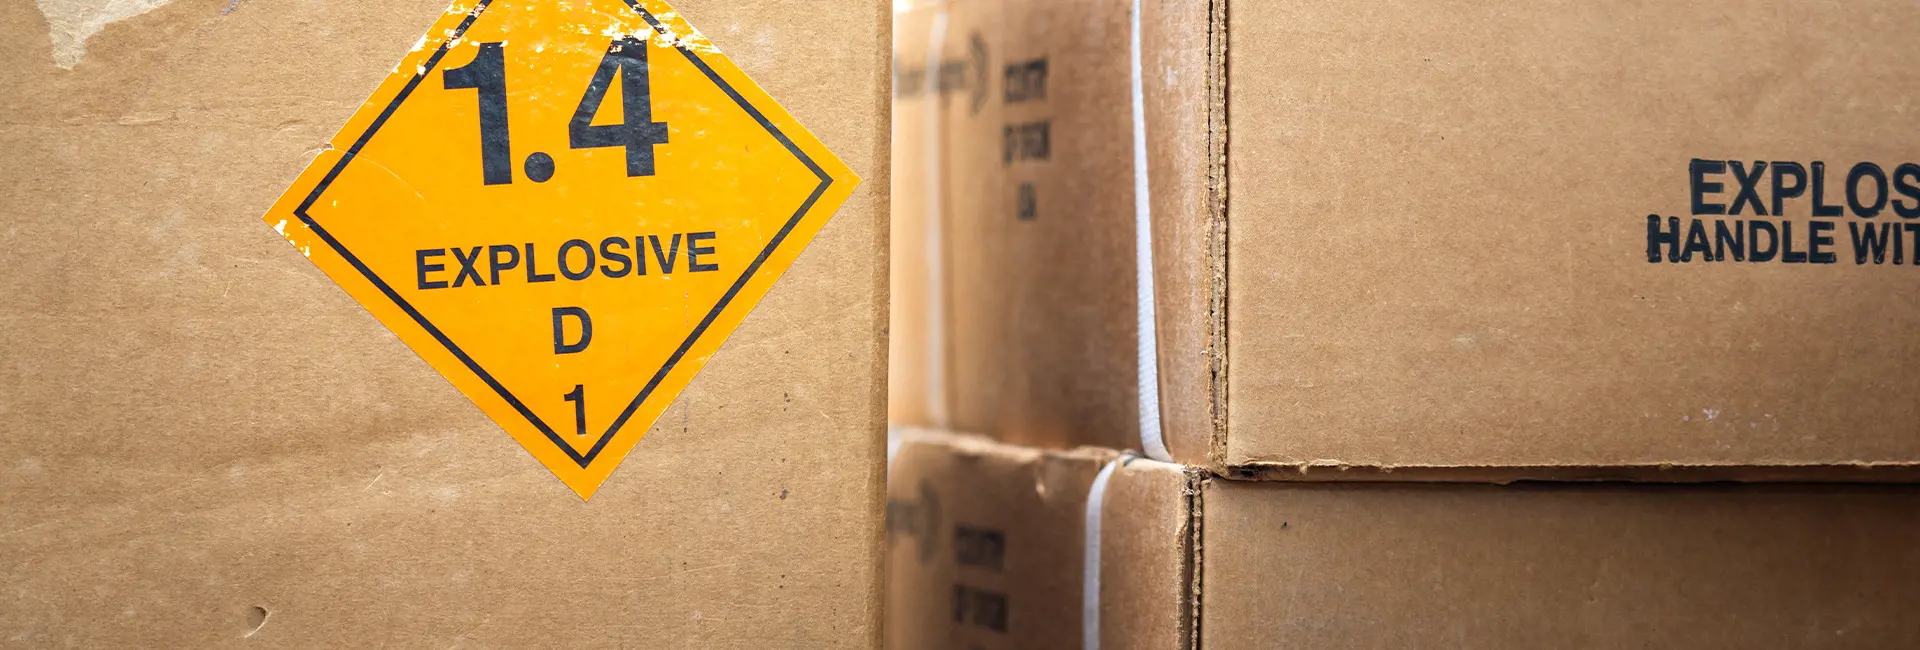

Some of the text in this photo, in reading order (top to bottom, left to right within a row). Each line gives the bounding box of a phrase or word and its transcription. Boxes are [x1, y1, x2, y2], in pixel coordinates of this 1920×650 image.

[443, 36, 669, 186] 1.4
[1688, 158, 1920, 219] EXPLOS
[415, 231, 719, 290] EXPLOSIVE
[1646, 213, 1837, 264] HANDLE
[551, 306, 593, 355] D
[563, 384, 587, 435] 1
